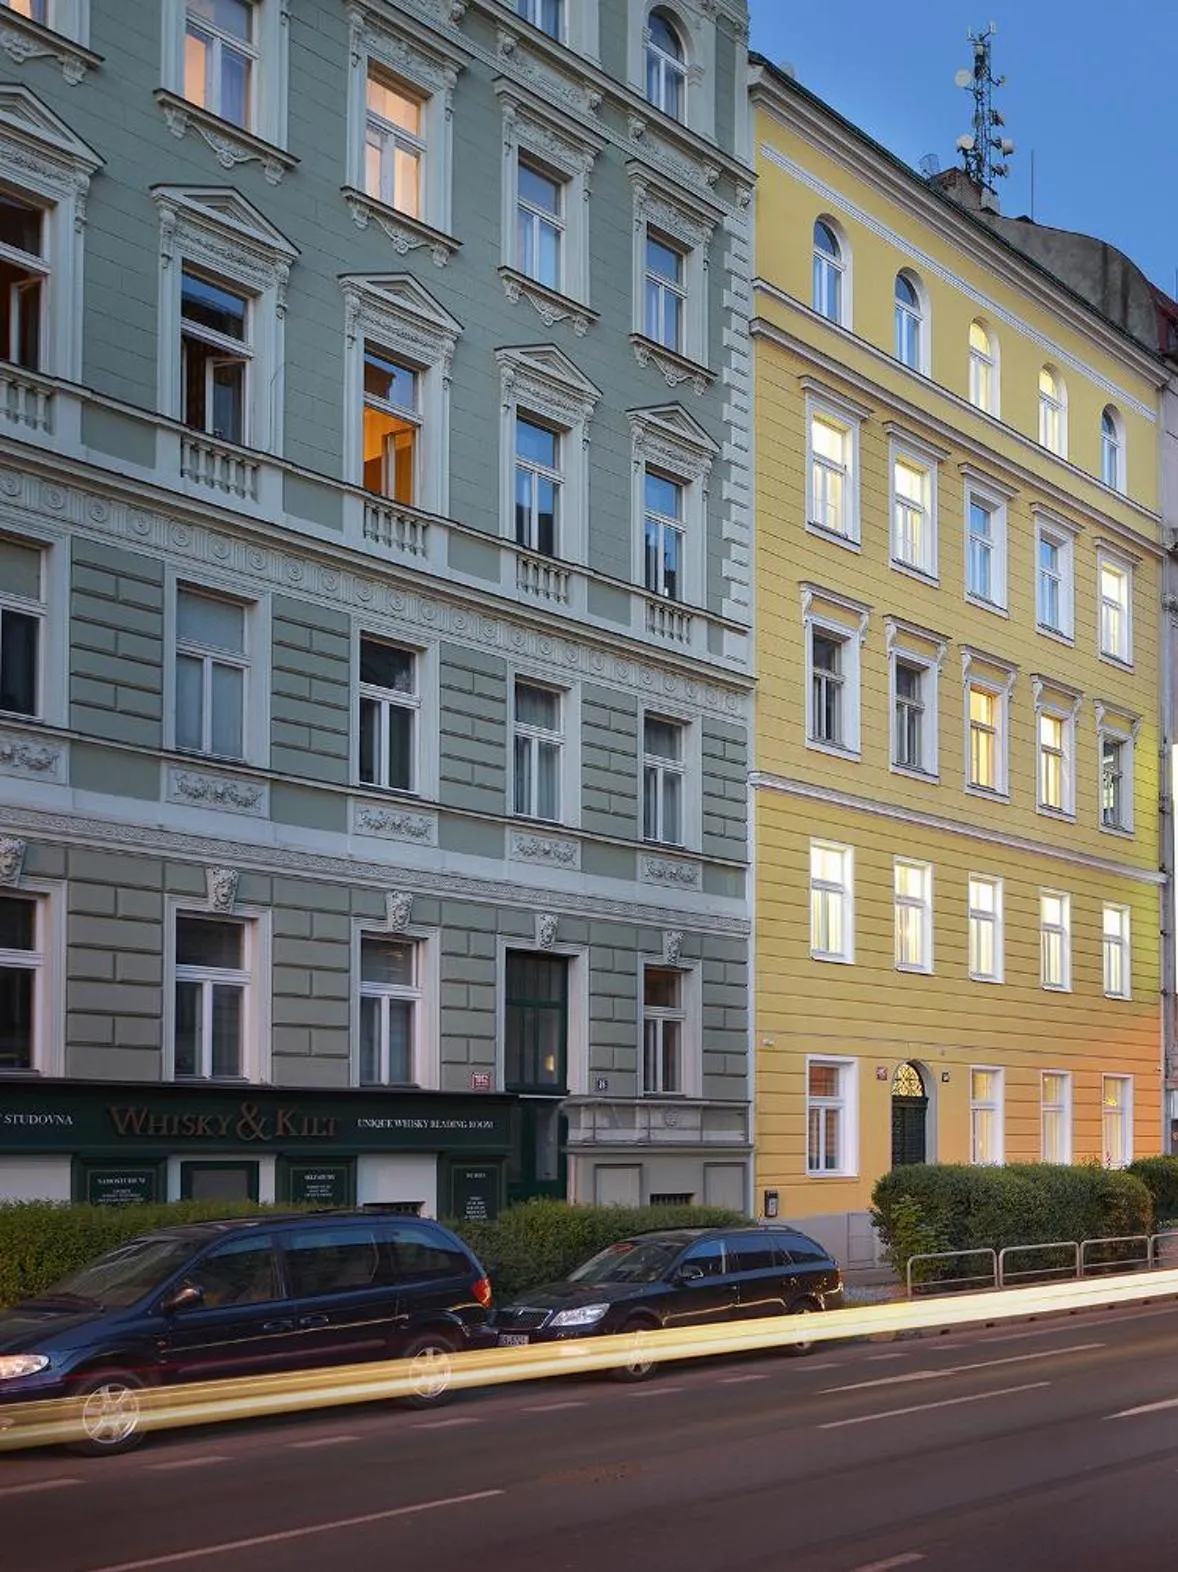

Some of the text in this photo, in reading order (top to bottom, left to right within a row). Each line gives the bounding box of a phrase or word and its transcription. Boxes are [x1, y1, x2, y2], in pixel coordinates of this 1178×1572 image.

[3, 1113, 74, 1126] STUDOVNA
[235, 1101, 272, 1141] &
[357, 1118, 394, 1129] UNIQUE
[395, 1118, 429, 1129] WHISKY
